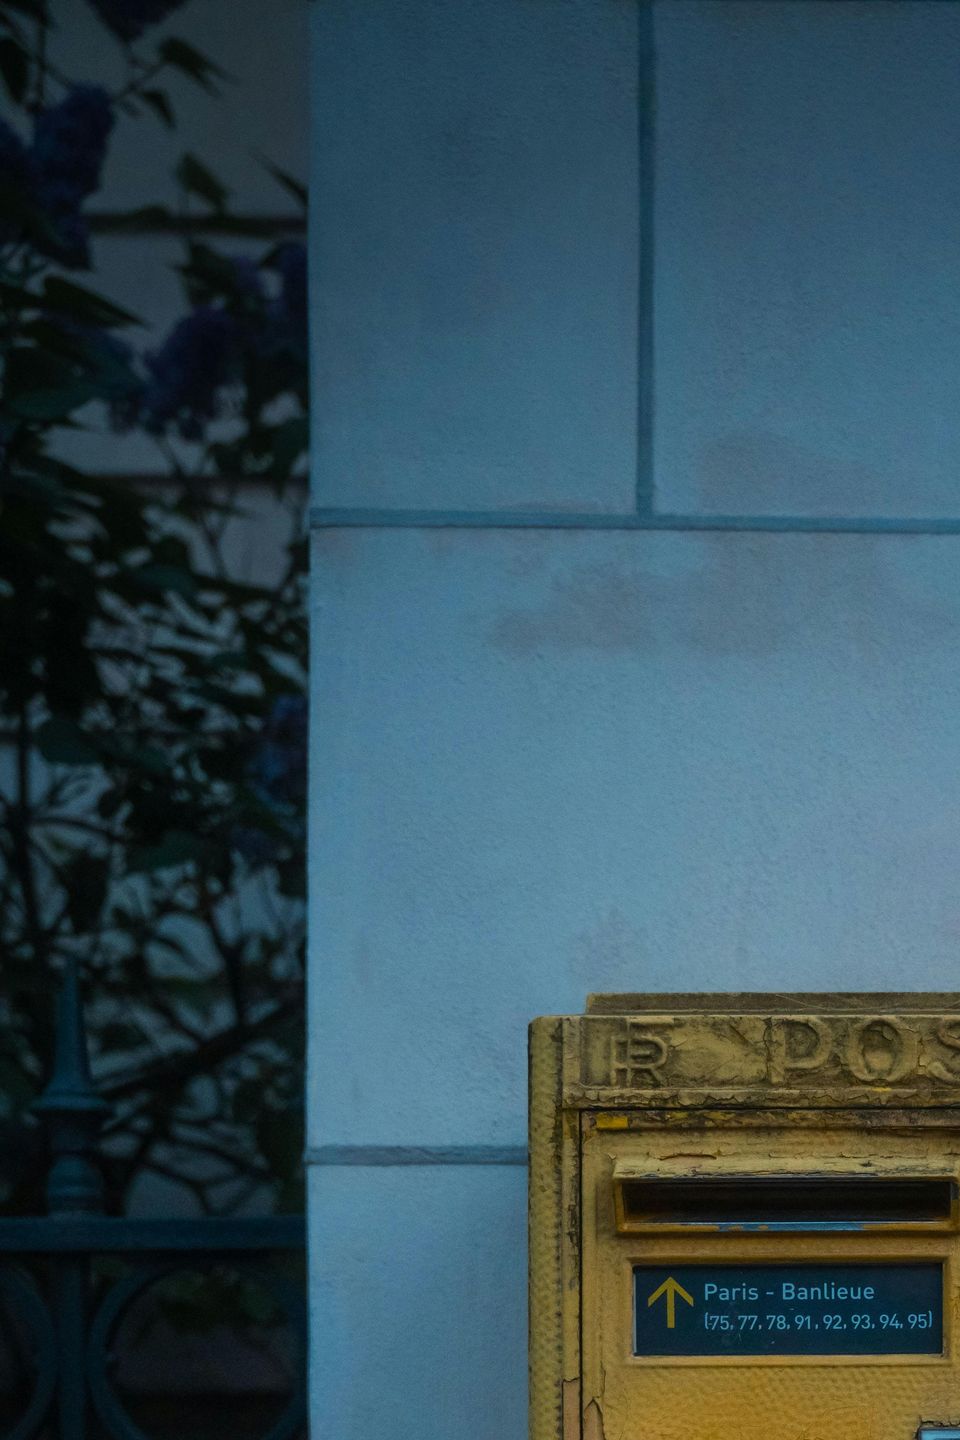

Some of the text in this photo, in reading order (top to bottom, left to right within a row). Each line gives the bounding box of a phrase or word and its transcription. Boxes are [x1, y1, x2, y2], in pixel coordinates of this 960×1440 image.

[703, 1282, 759, 1301] Paris
[781, 1281, 875, 1300] Banlieue
[907, 1309, 933, 1329] 95)
